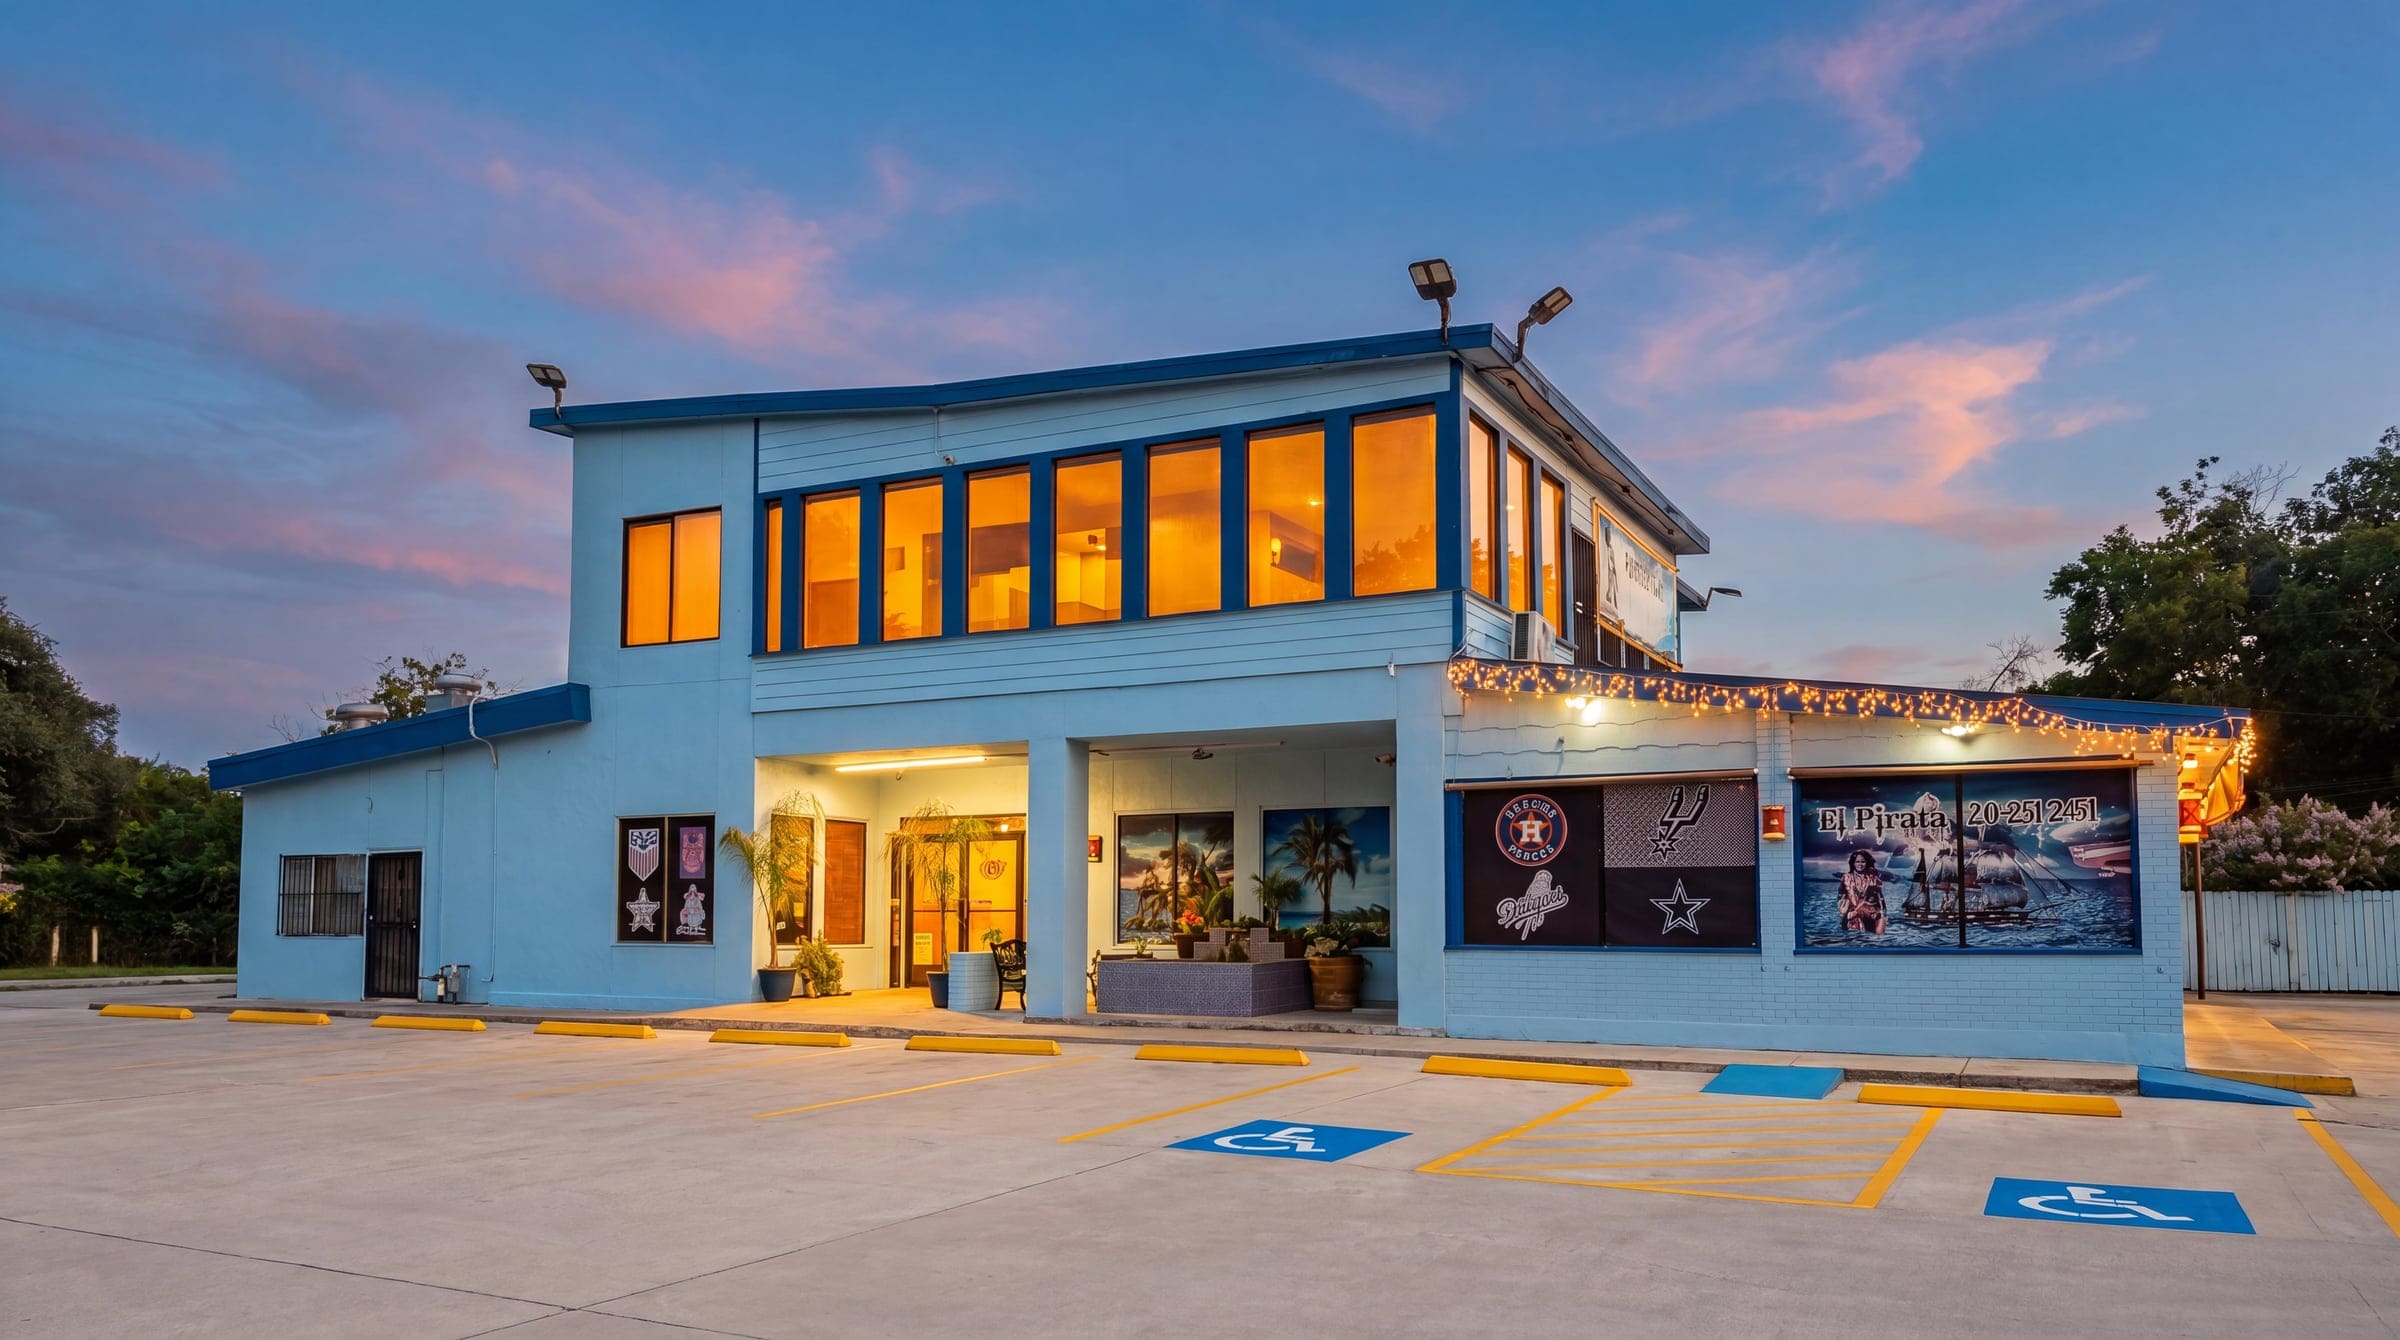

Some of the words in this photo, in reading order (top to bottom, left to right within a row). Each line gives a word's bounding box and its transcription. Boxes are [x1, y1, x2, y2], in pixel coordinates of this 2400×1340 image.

[1818, 806, 1846, 839] El
[1855, 804, 1948, 839] Pirata
[2046, 798, 2098, 822] 2451
[1519, 821, 1543, 842] H
